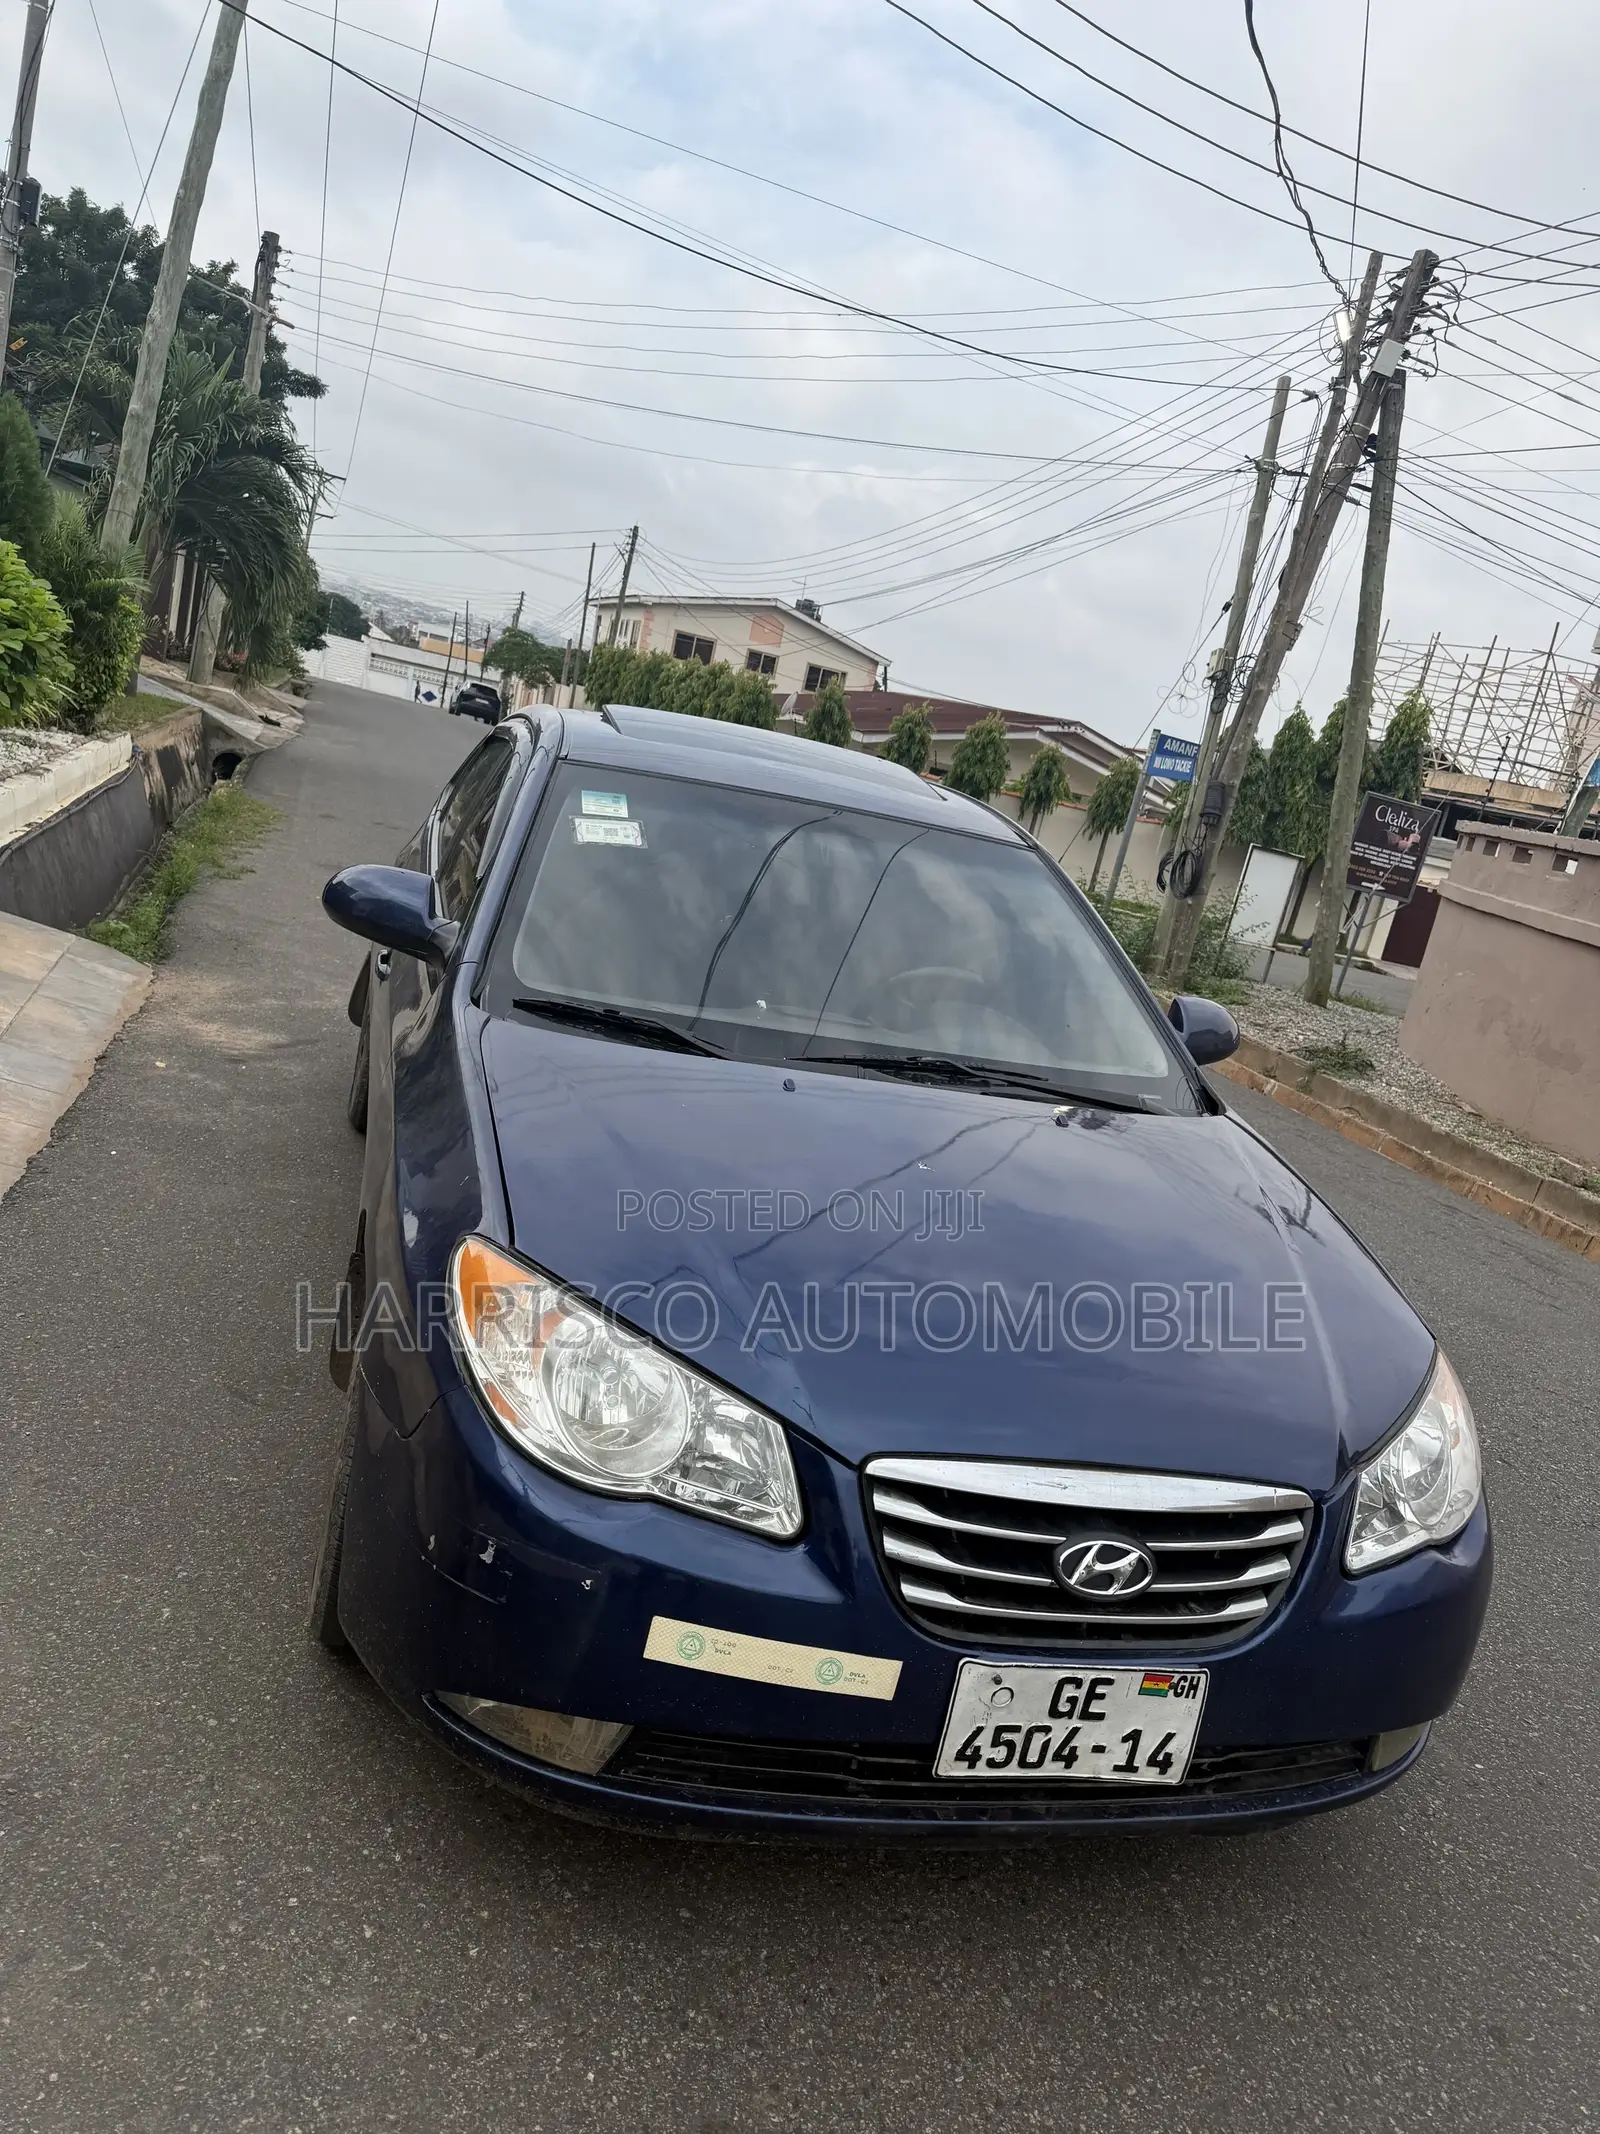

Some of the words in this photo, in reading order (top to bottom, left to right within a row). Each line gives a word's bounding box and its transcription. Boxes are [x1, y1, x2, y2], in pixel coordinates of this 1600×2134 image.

[1048, 1675, 1115, 1721] GE
[1173, 1675, 1201, 1699] GH
[954, 1724, 1178, 1776] 4504-14
